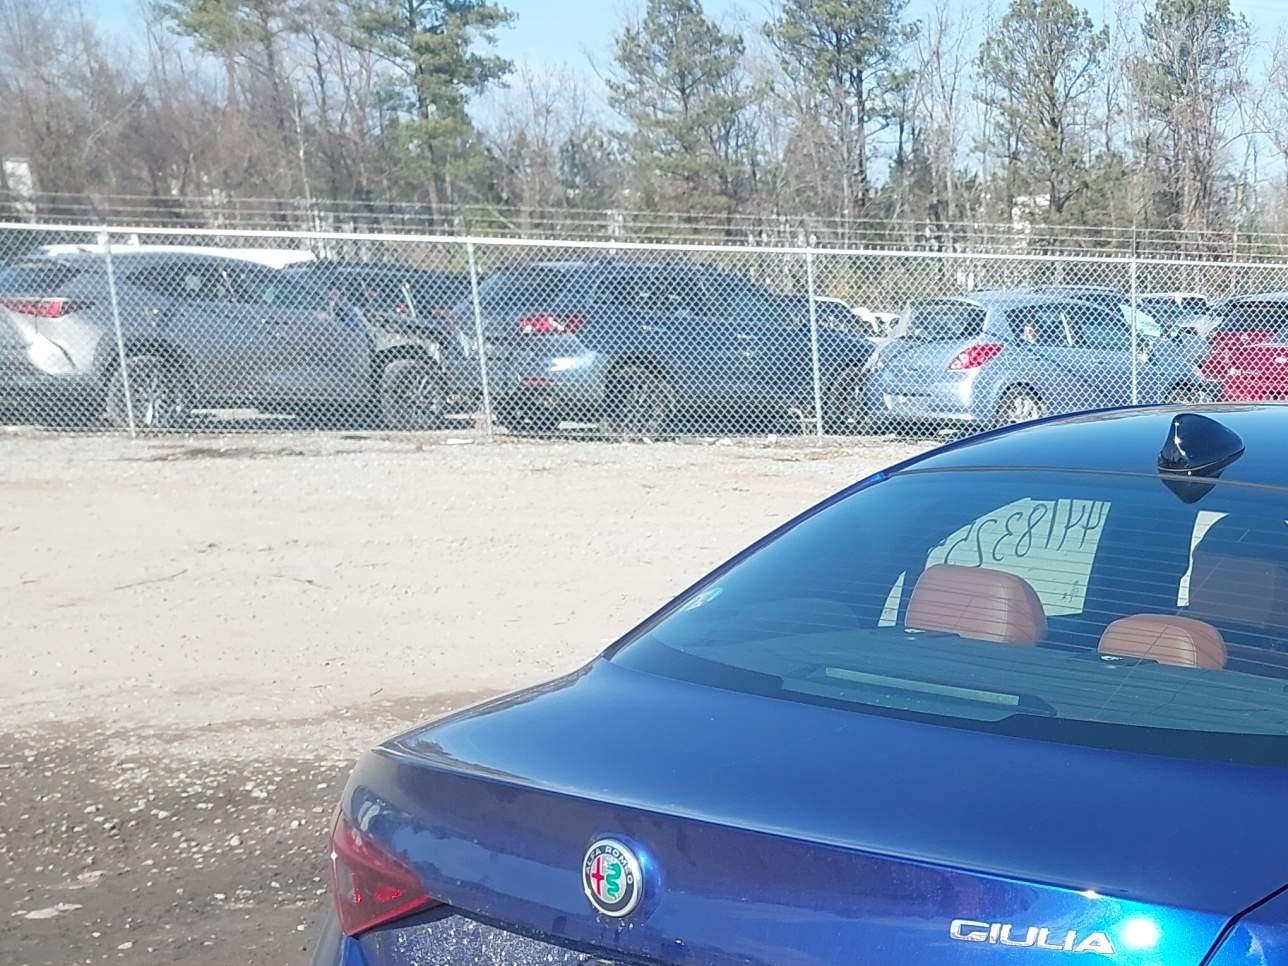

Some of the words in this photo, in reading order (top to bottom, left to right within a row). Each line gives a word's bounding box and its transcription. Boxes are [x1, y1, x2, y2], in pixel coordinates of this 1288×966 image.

[586, 848, 601, 875] ALFA
[605, 846, 633, 885] ROMEO
[949, 918, 1115, 955] GIULIA
